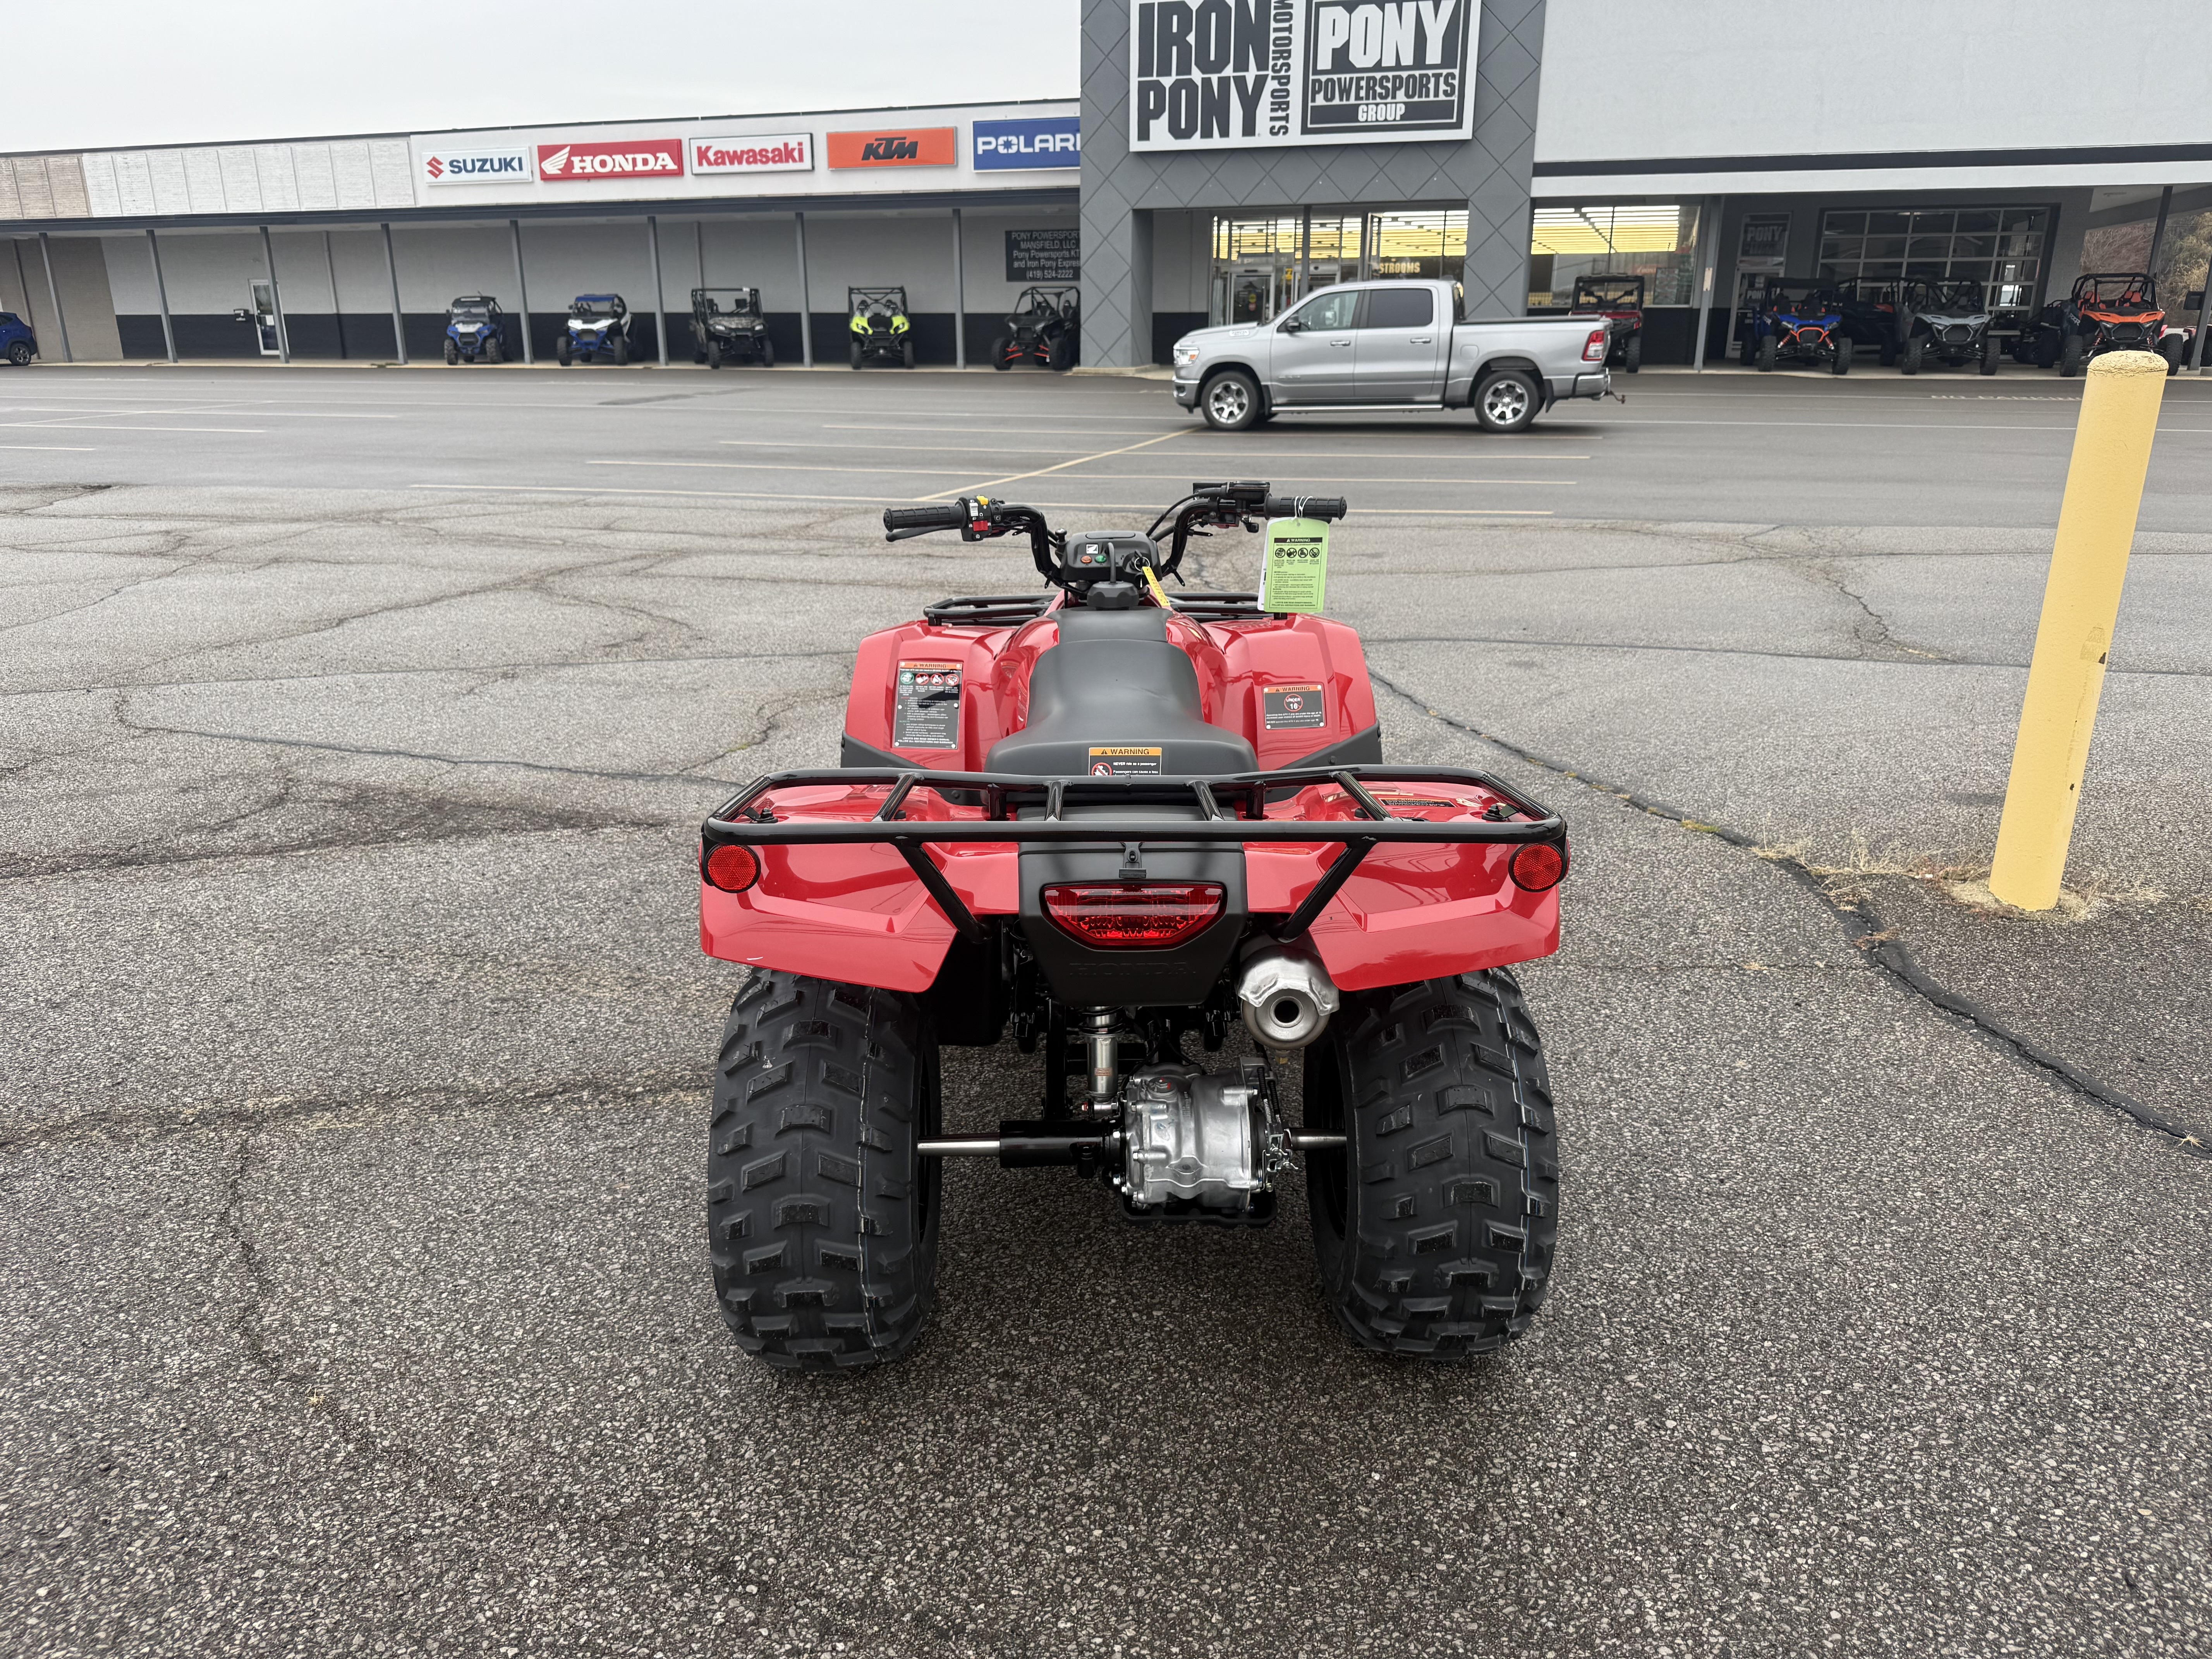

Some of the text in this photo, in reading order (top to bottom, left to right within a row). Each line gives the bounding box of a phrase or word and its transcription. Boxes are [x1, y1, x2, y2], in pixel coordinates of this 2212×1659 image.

[1138, 0, 1271, 77] IRON
[1317, 0, 1456, 70] PONY
[1269, 0, 1293, 136] MOTORSPORTS
[1311, 72, 1456, 103] POWERSPORTS
[1138, 74, 1269, 141] PONY
[1358, 103, 1405, 122] GROUP
[861, 136, 919, 161] KTM
[977, 133, 1081, 155] POLARI
[571, 153, 678, 173] HONDA
[696, 142, 804, 167] Kawasaki
[449, 156, 523, 174] SUZUKI
[1012, 231, 1080, 240] PONY POWERSPOR
[1063, 240, 1076, 248] LLC
[1747, 226, 1782, 242] PONY
[1013, 249, 1080, 259] Pony Powersports KT
[1040, 259, 1056, 269] Pony
[1058, 259, 1080, 269] Expres
[1026, 270, 1073, 280] (419) 524-2222
